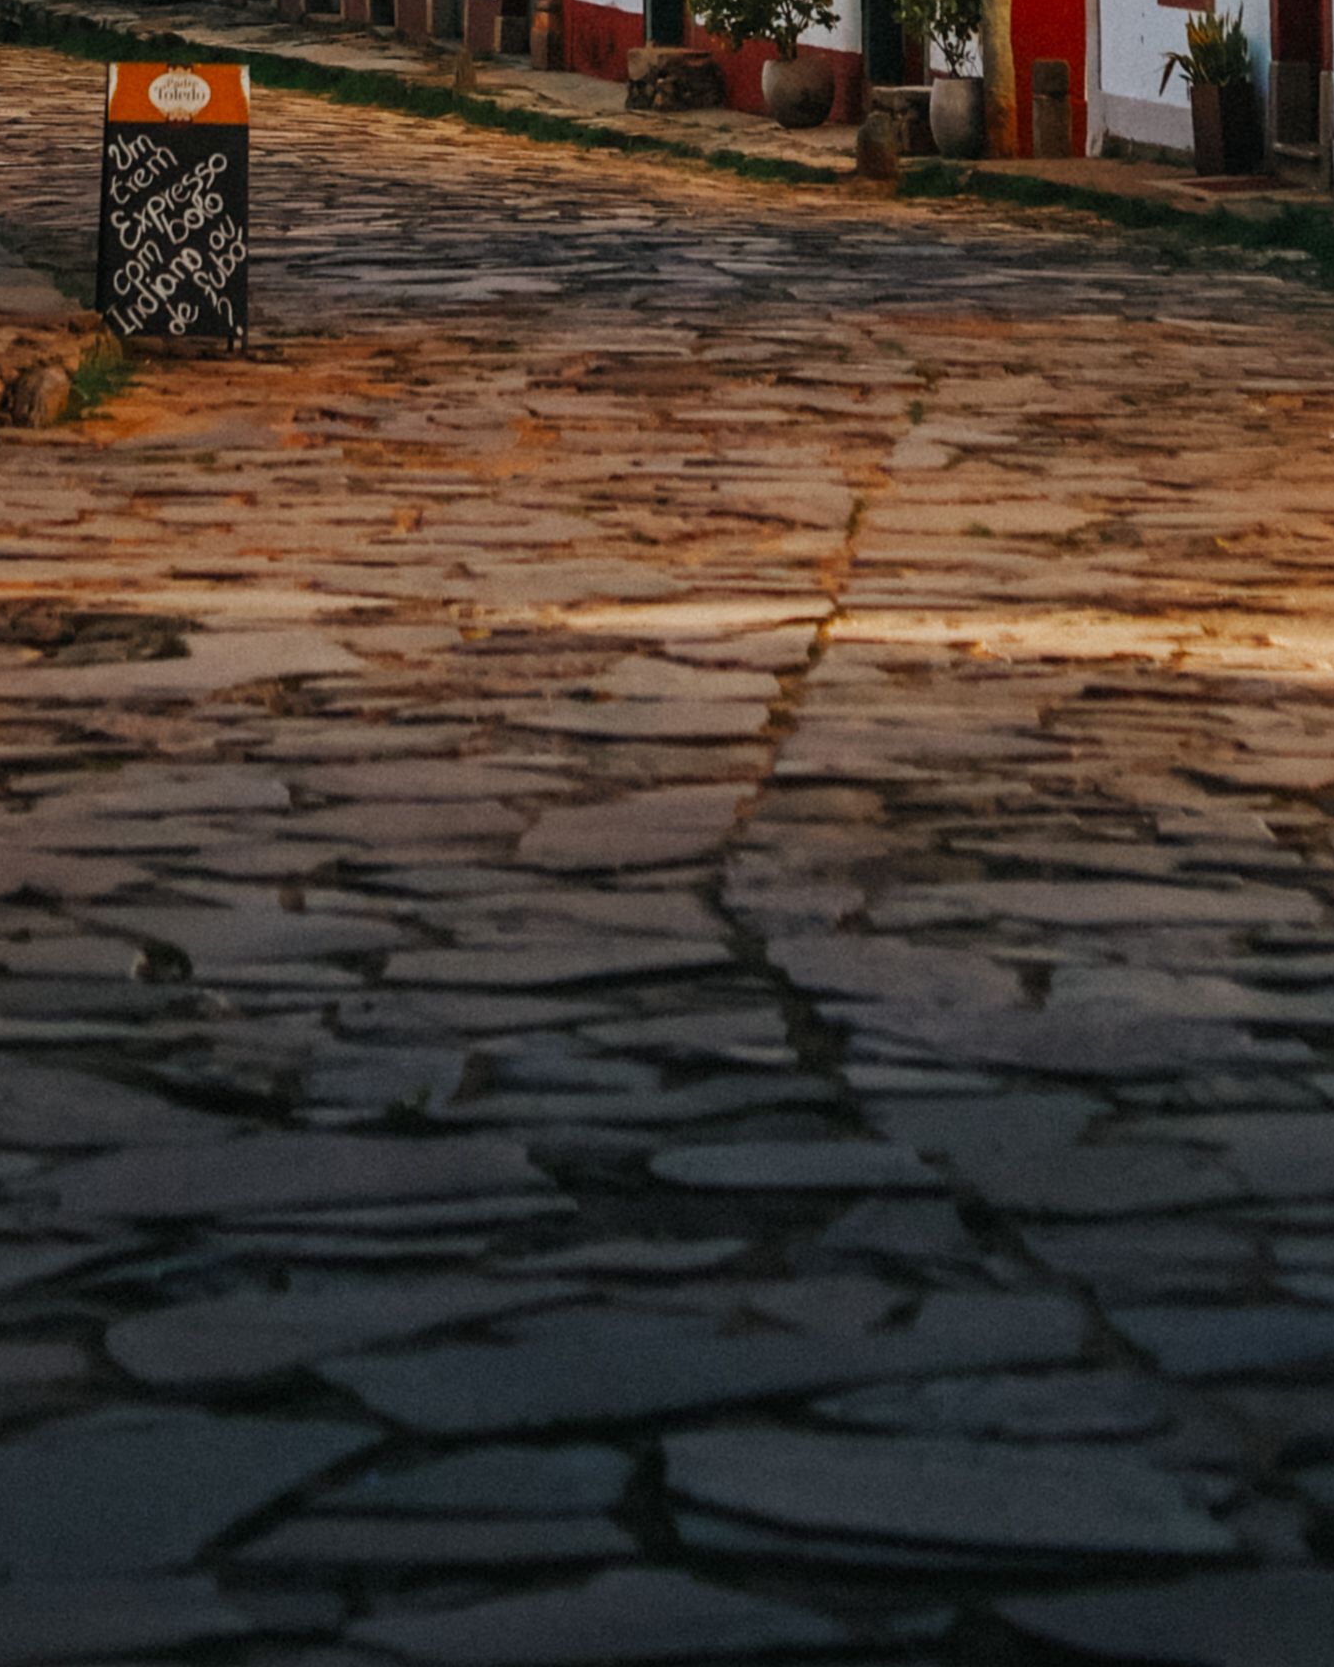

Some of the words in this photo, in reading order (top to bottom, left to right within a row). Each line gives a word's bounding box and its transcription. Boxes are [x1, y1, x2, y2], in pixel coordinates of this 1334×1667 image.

[156, 87, 206, 102] Toledo
[108, 133, 158, 170] Um
[109, 146, 179, 204] trem
[110, 152, 228, 250] Expresso
[165, 301, 199, 335] de
